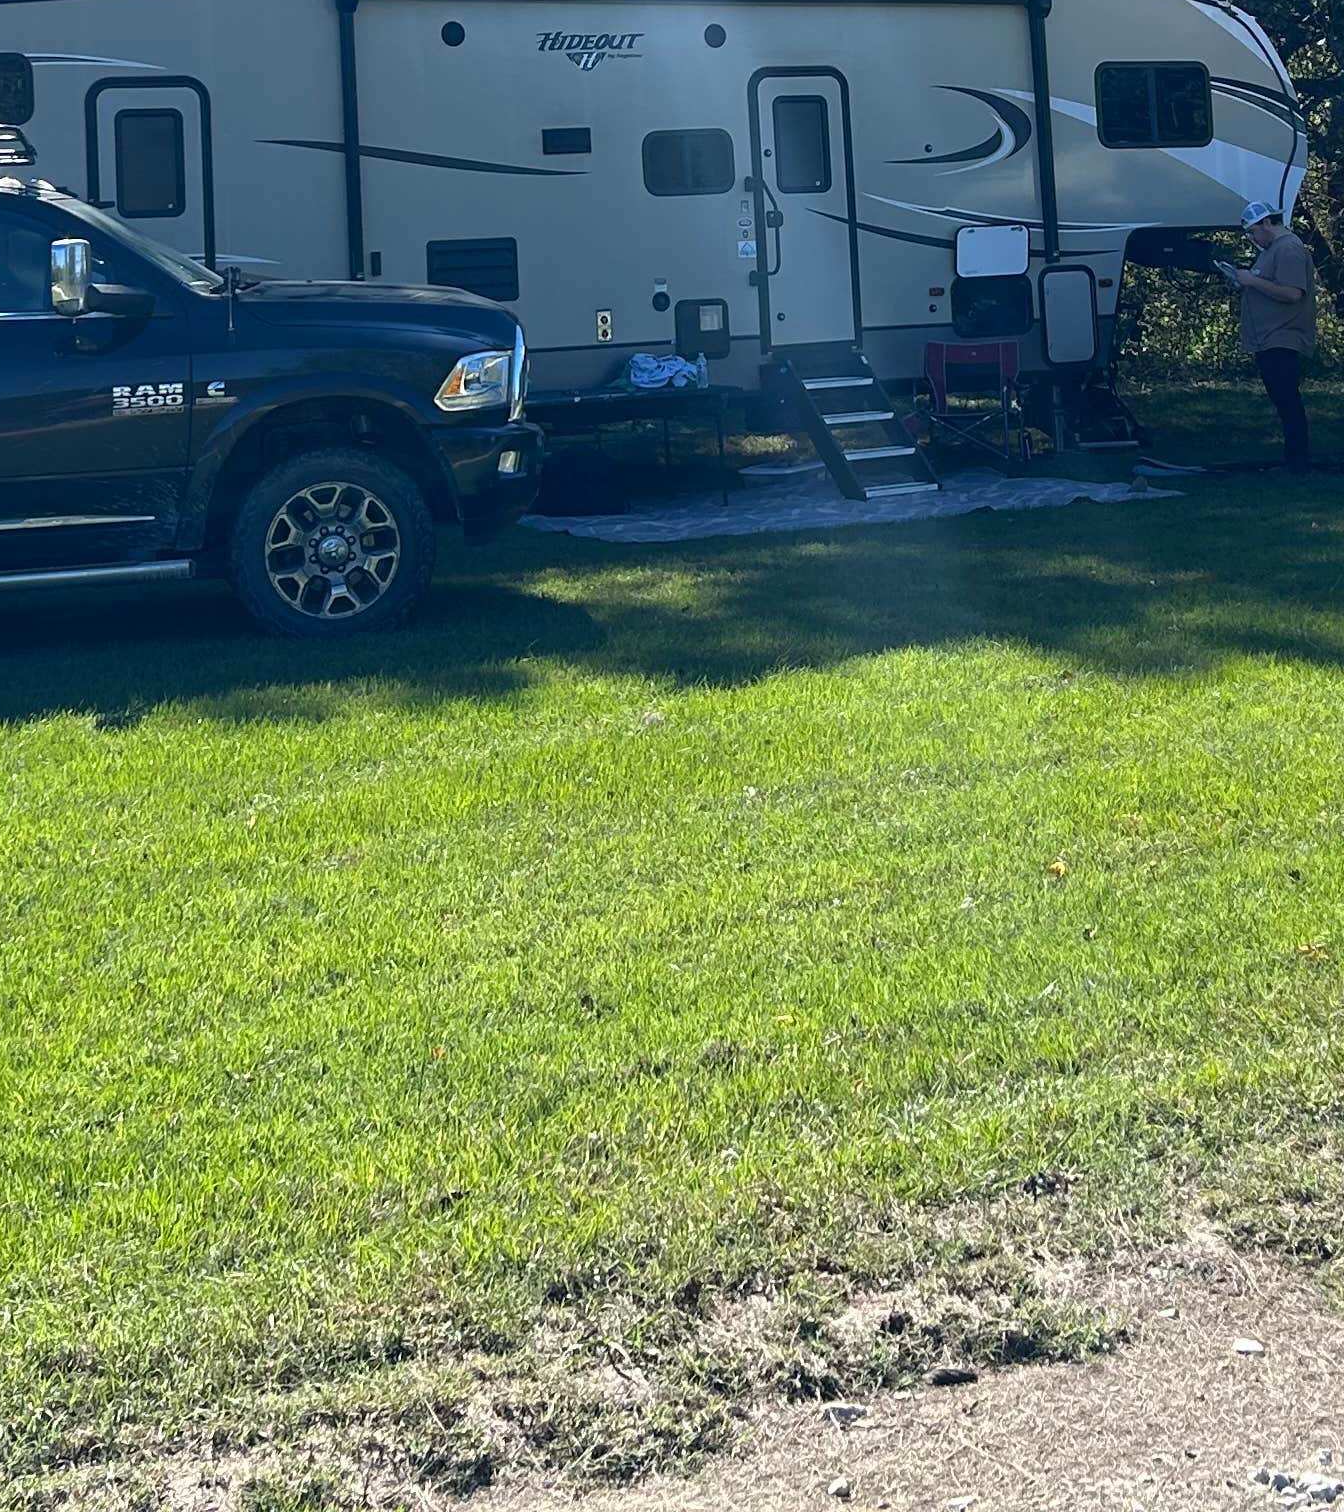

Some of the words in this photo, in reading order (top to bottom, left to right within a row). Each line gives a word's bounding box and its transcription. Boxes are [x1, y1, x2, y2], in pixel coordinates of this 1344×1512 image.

[536, 31, 644, 51] HIDEOUT
[112, 383, 183, 397] RAM
[113, 395, 184, 408] 3500
